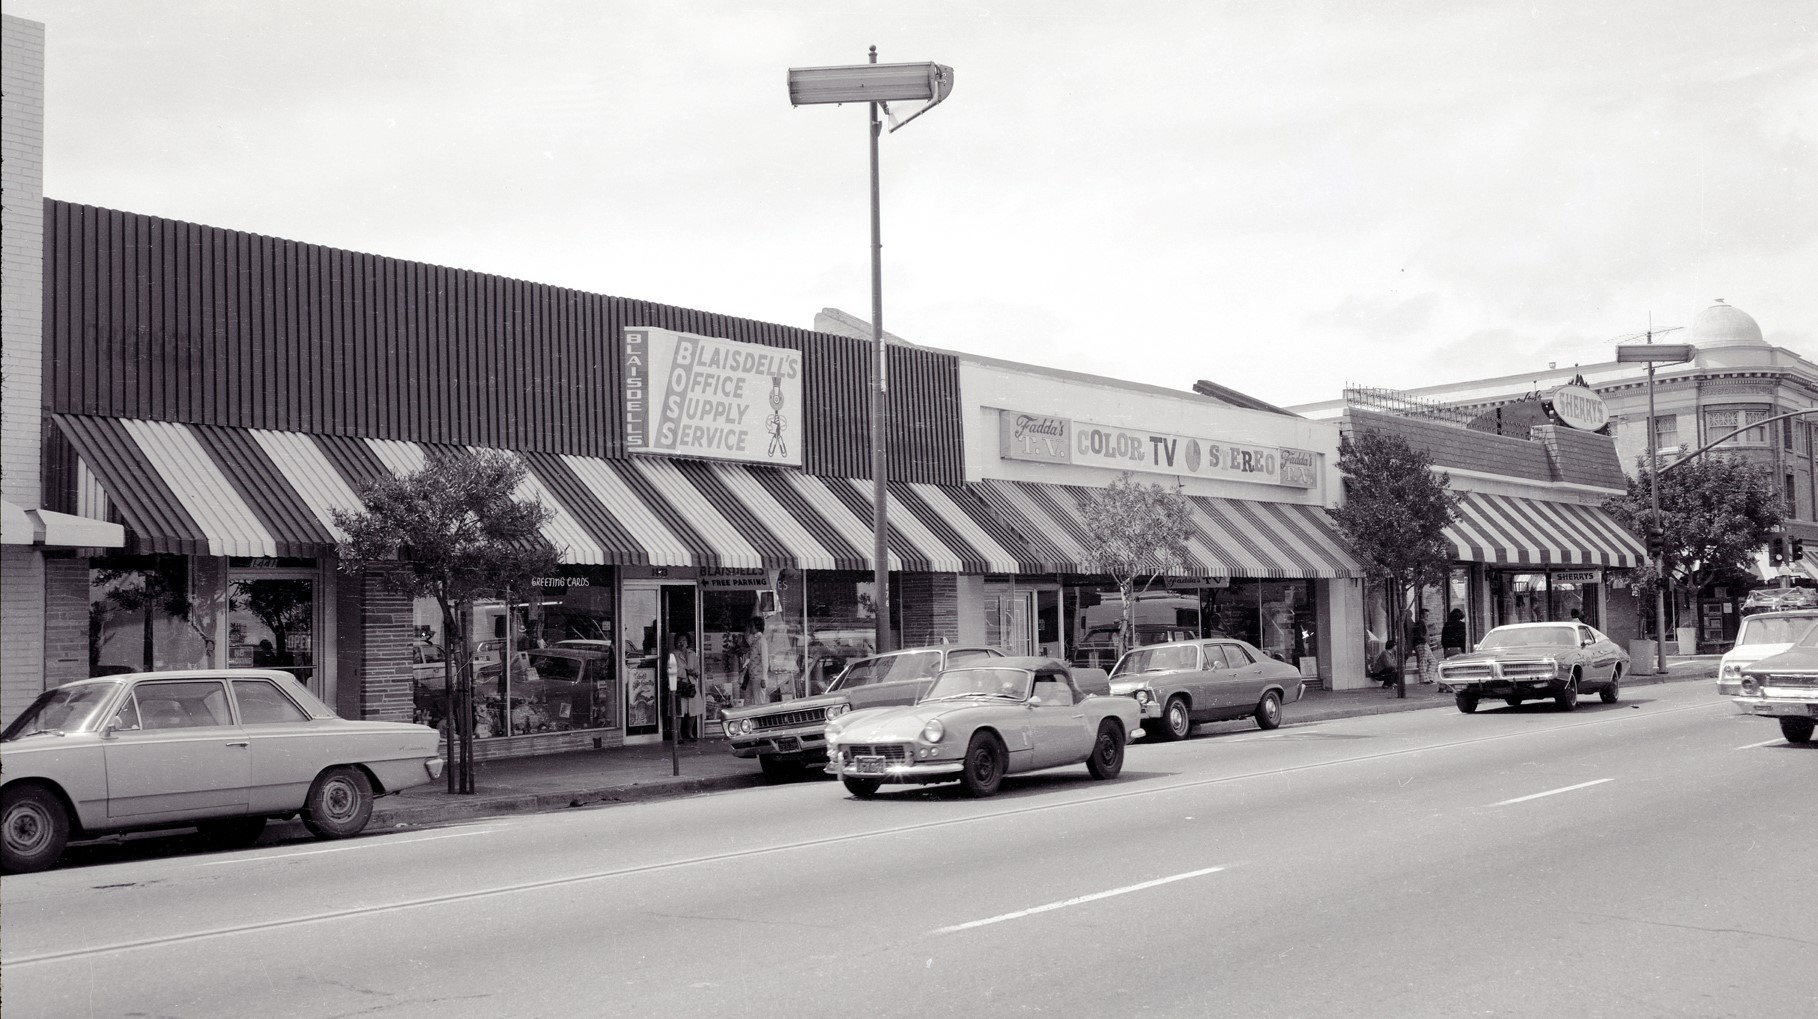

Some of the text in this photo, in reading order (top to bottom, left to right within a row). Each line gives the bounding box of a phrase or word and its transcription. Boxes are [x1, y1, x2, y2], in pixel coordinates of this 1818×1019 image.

[676, 341, 799, 380] BLAISDELL'S
[626, 333, 642, 445] BLAISDELLS
[671, 367, 747, 399] OFFICE
[666, 395, 750, 425] SUPPLY
[660, 422, 749, 451] SERVICE
[1014, 414, 1064, 438] Fadda's
[1018, 434, 1065, 457] T.V.
[1077, 429, 1276, 475] COLOR TV STEREO
[1280, 449, 1313, 469] Fadda's
[1284, 466, 1314, 485] T.V.
[531, 576, 590, 587] GREETING CARDS
[711, 578, 767, 587] FREE PARKING
[1202, 576, 1223, 584] TV
[1556, 572, 1594, 580] SHERRYS
